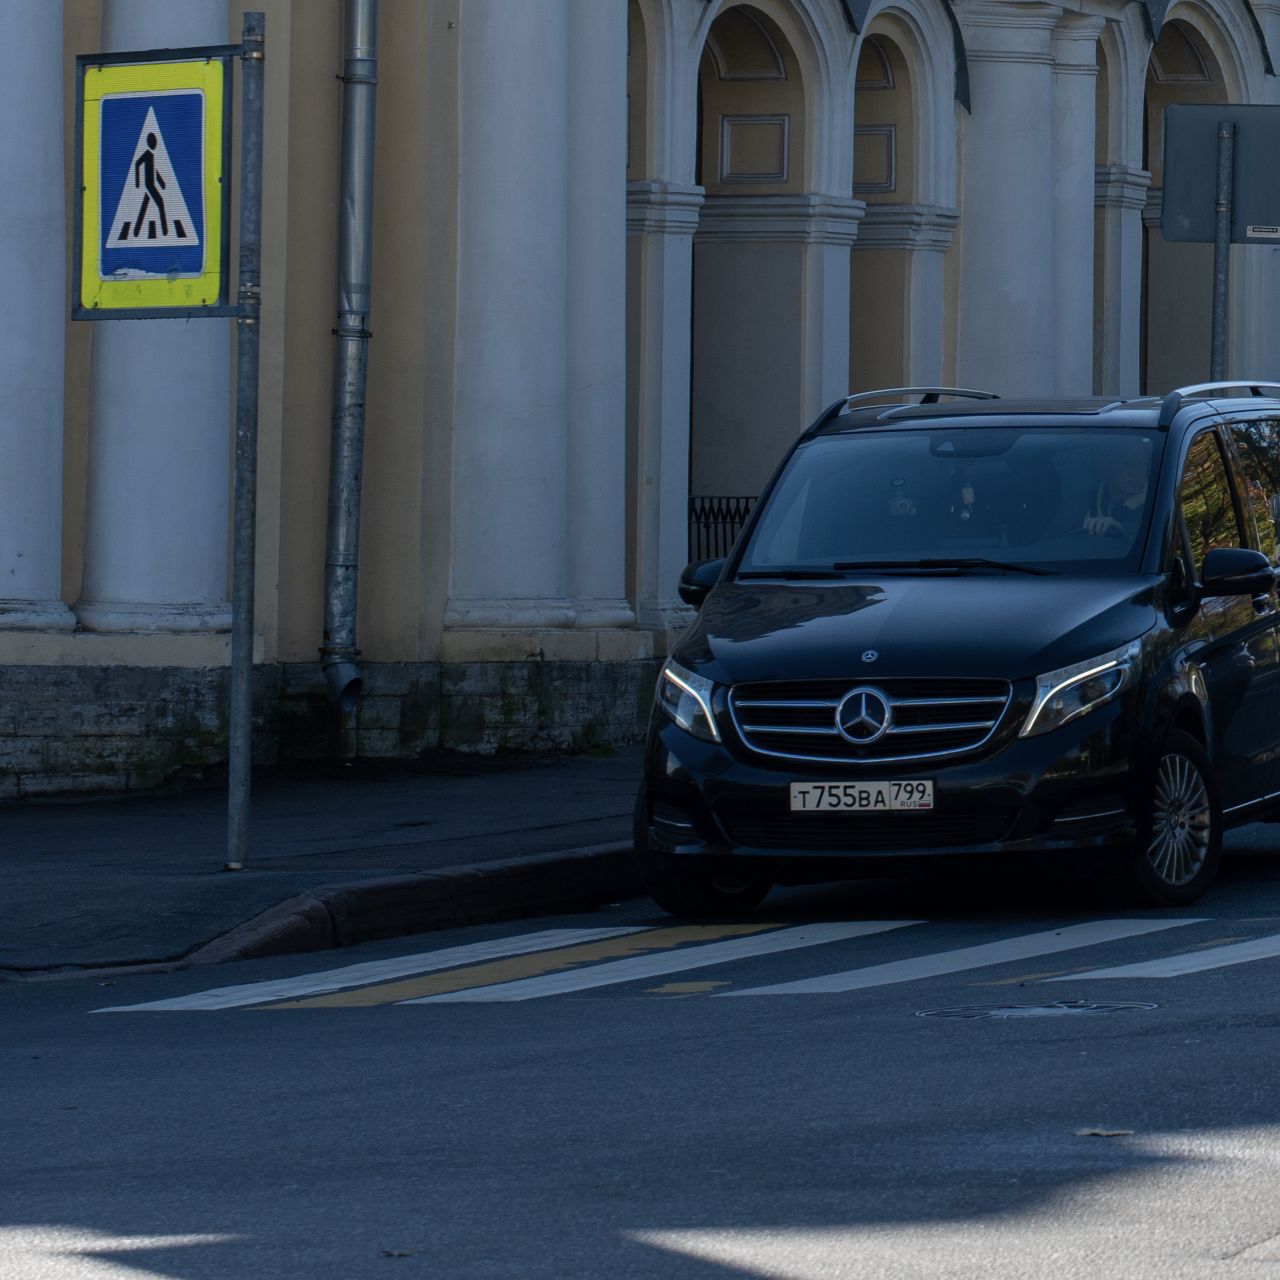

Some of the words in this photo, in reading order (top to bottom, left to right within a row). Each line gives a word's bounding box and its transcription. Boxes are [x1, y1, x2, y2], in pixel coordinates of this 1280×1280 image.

[798, 784, 887, 809] Т755ВА
[891, 782, 927, 801] 799
[900, 800, 918, 808] RUS
